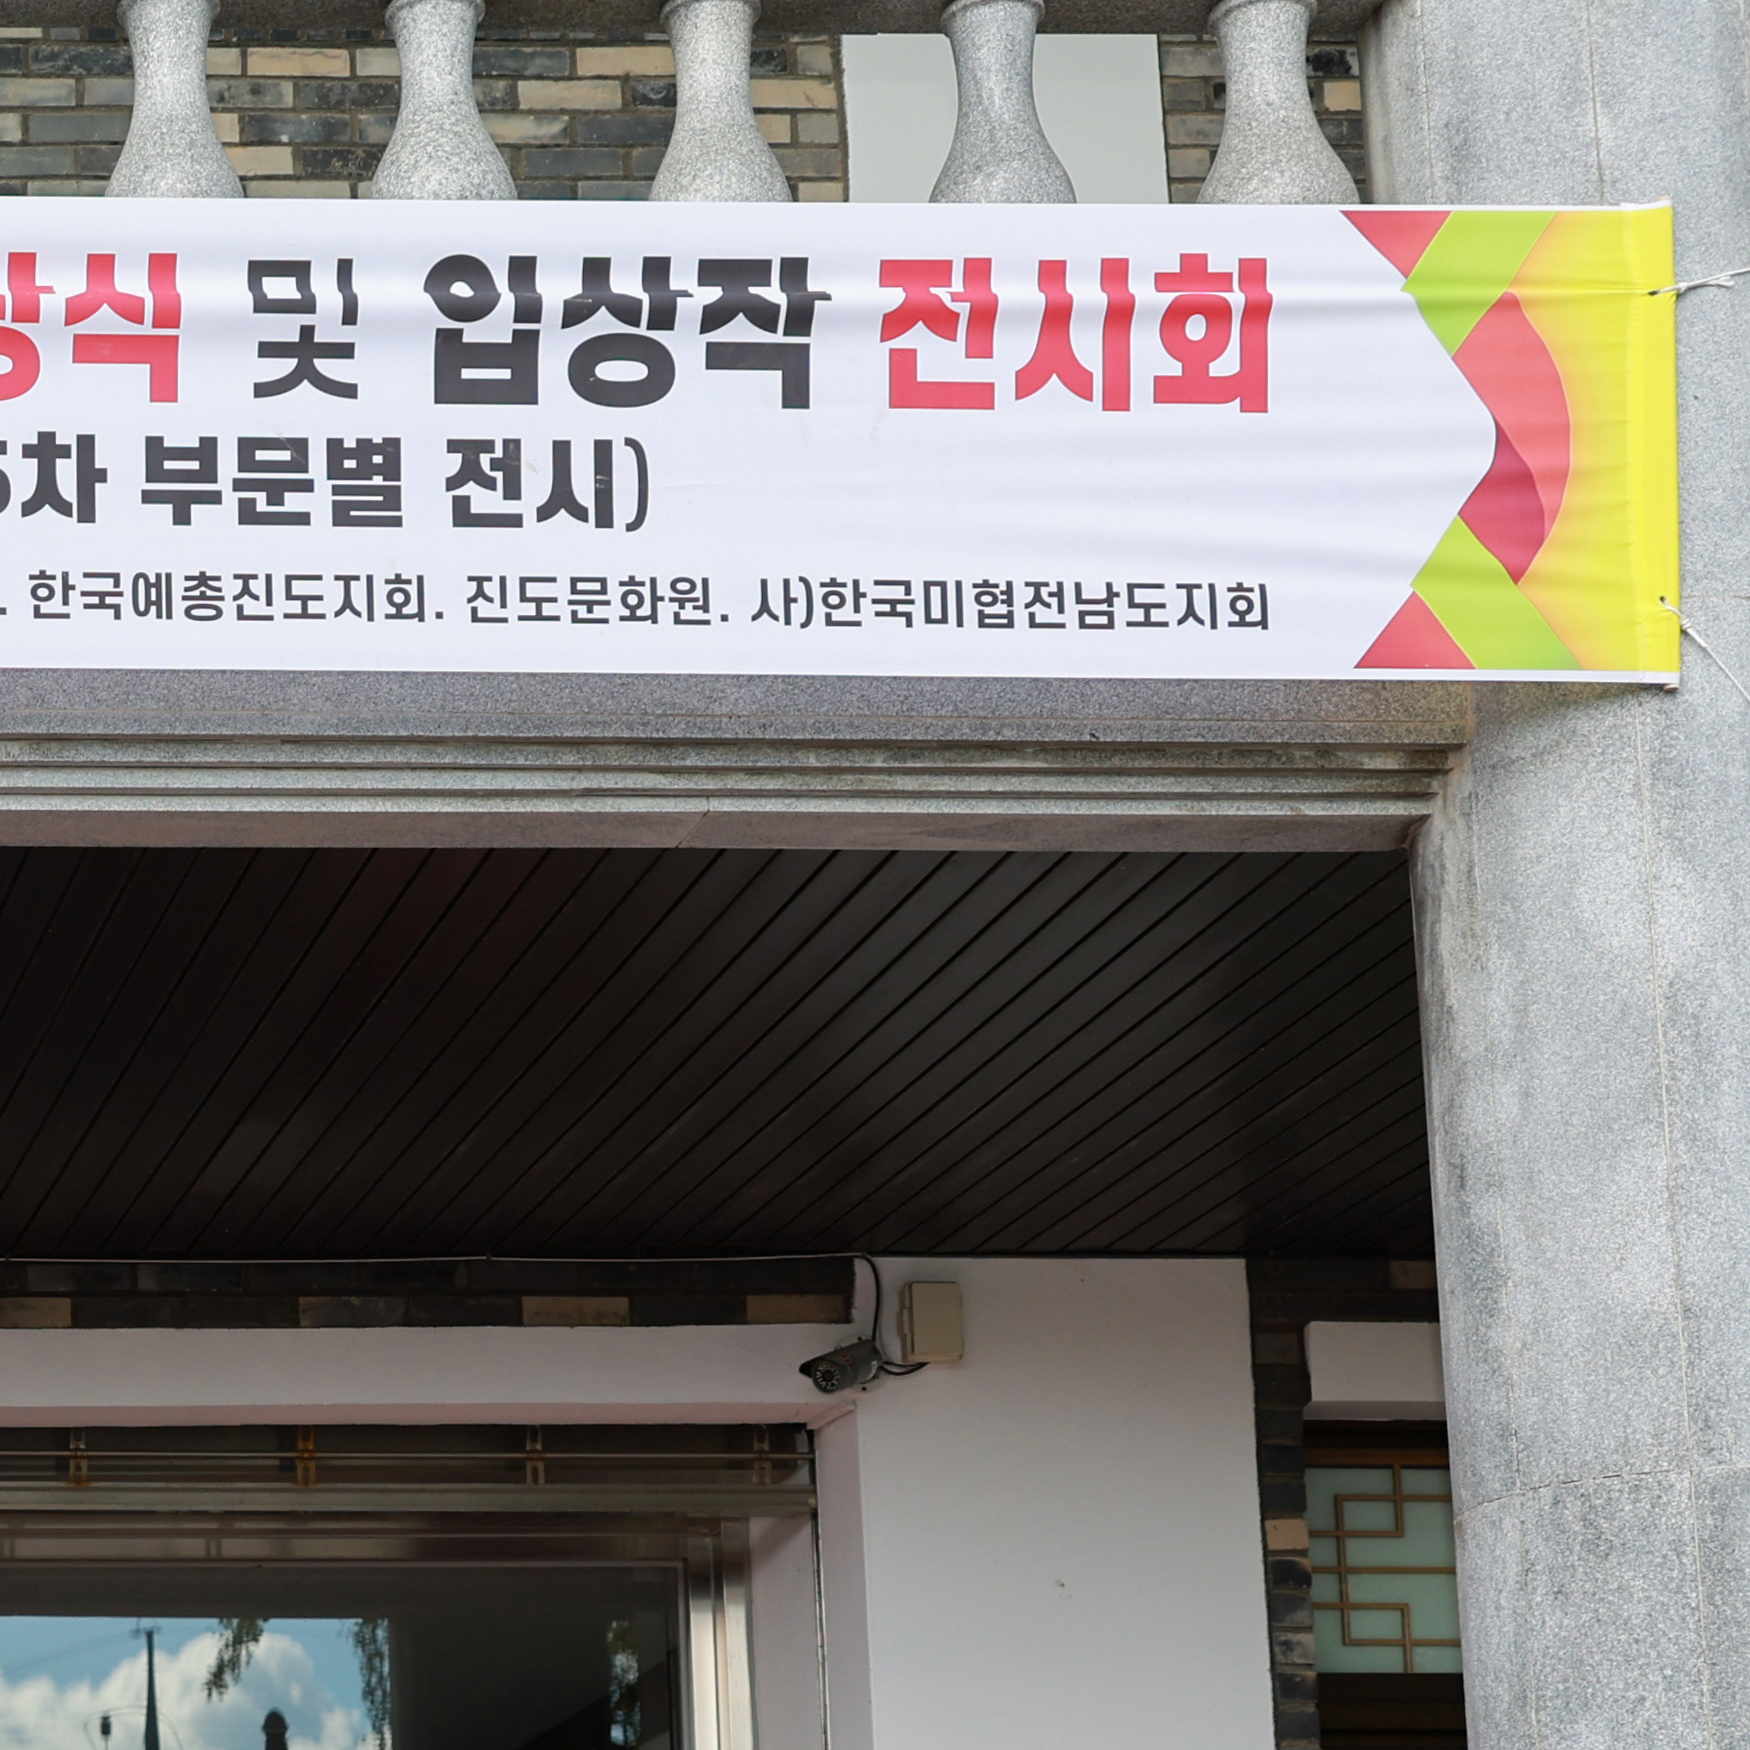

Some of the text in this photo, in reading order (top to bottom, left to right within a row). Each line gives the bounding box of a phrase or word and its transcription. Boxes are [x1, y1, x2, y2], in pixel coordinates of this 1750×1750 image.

[248, 259, 359, 400] 및
[425, 255, 833, 410] 입상작
[880, 254, 1274, 414] 전시회
[142, 437, 404, 528] 부문별
[447, 438, 649, 533] 전시)
[30, 571, 444, 623] 한국예총진도지회.
[468, 576, 730, 626] 진도문화원.
[752, 577, 1269, 631] 사)한국미협전남도지회
